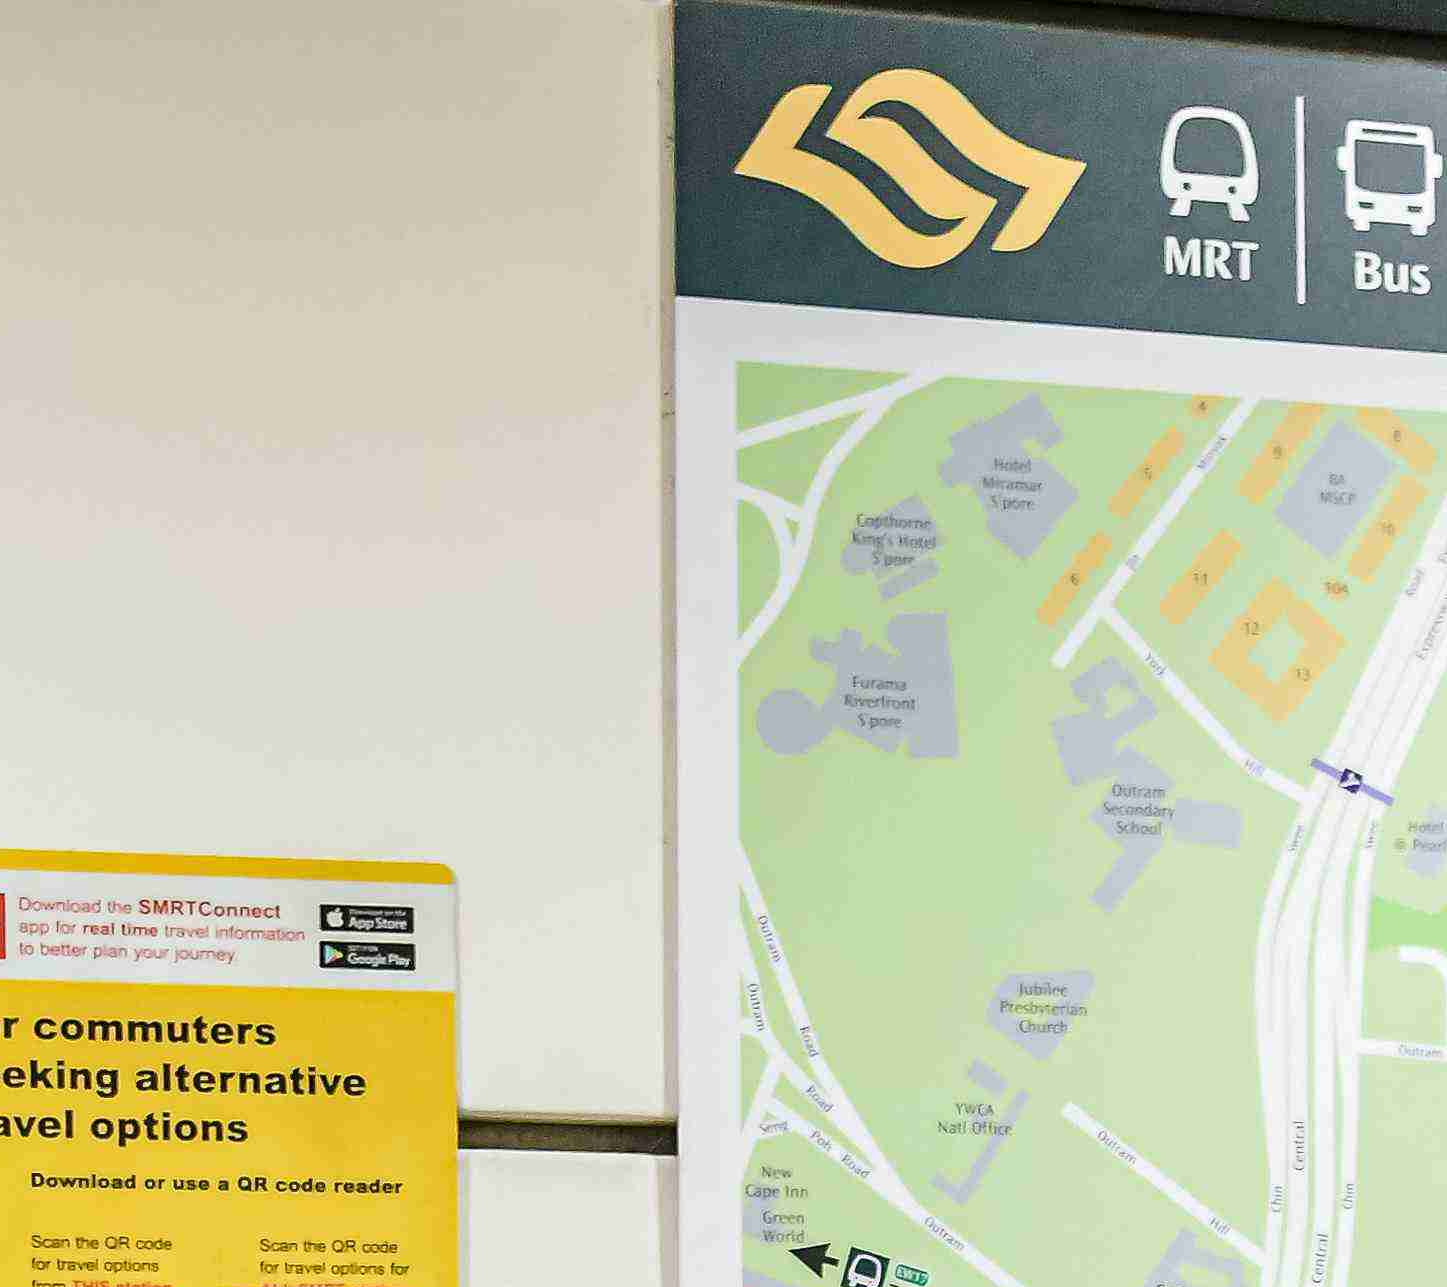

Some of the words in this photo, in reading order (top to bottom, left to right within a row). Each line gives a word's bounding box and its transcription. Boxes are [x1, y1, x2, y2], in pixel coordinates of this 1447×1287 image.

[1164, 236, 1258, 282] MRT
[1355, 252, 1431, 296] Bus
[994, 459, 1032, 473] Hotel
[983, 477, 1042, 493] Miramar
[853, 677, 906, 692] Furama
[845, 695, 915, 711] Riverfront
[1111, 785, 1166, 799] Outram
[1103, 804, 1175, 820] Secondary
[1116, 822, 1162, 835] School
[19, 897, 101, 914] Download
[108, 902, 132, 914] the
[138, 900, 280, 918] SMRTConnect
[19, 920, 49, 936] app
[56, 921, 76, 934] for
[83, 923, 114, 936] real
[122, 924, 158, 936] time
[164, 924, 208, 938] travel
[216, 926, 305, 941] information
[348, 917, 374, 930] App
[375, 917, 407, 929] Store
[19, 942, 34, 956] to
[40, 943, 86, 957] better
[94, 944, 128, 959] plan
[134, 946, 168, 962] your
[1019, 983, 1068, 998] Jubilee
[1000, 1002, 1088, 1018] Presbyterian
[33, 1013, 276, 1045] commuters
[1019, 1020, 1067, 1034] Church
[135, 1063, 366, 1096] alternative
[955, 1104, 994, 1117] YWCA
[91, 1113, 248, 1145] options
[762, 1167, 792, 1179] New
[32, 1172, 136, 1190] Download
[145, 1177, 165, 1190] or
[173, 1178, 209, 1191] use
[218, 1179, 229, 1191] a
[238, 1177, 267, 1192] QR
[276, 1178, 325, 1192] code
[334, 1180, 403, 1194] reader
[746, 1185, 780, 1201] Cape
[786, 1185, 808, 1198] Inn
[32, 1235, 70, 1249] Scan
[76, 1236, 98, 1249] the
[105, 1237, 130, 1250] QR
[136, 1237, 172, 1250] code
[260, 1239, 297, 1252] Scan
[304, 1240, 326, 1253] the
[332, 1240, 356, 1253] QR
[362, 1242, 397, 1253] code
[32, 1258, 51, 1272] for
[57, 1258, 98, 1272] travel
[104, 1259, 159, 1276] options
[260, 1261, 279, 1273] for
[285, 1262, 325, 1274] travel
[331, 1263, 384, 1276] options
[390, 1263, 410, 1275] for
